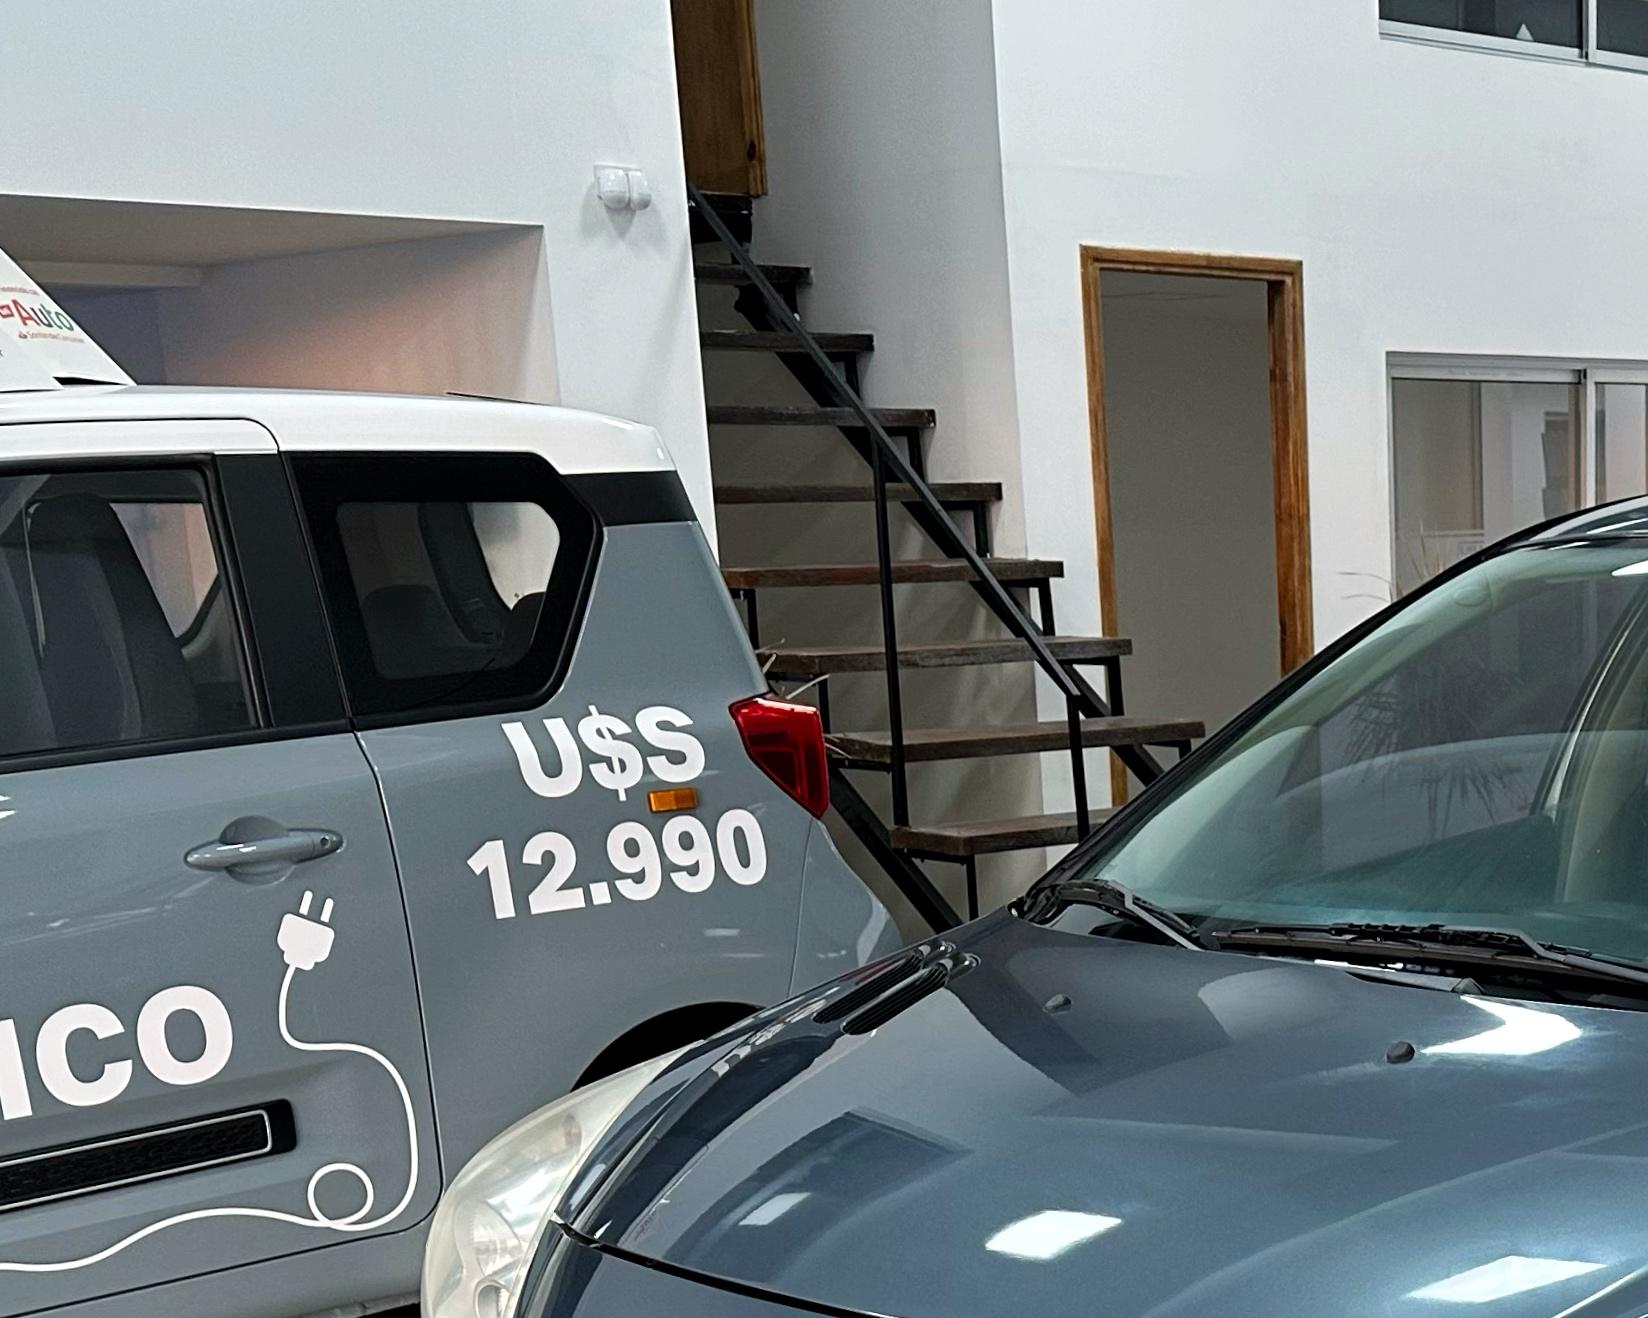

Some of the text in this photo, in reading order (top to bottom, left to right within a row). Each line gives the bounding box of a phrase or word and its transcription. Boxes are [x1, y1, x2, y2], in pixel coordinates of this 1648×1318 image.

[11, 299, 74, 332] Auto
[501, 705, 706, 801] U$S
[466, 808, 767, 919] 12.990
